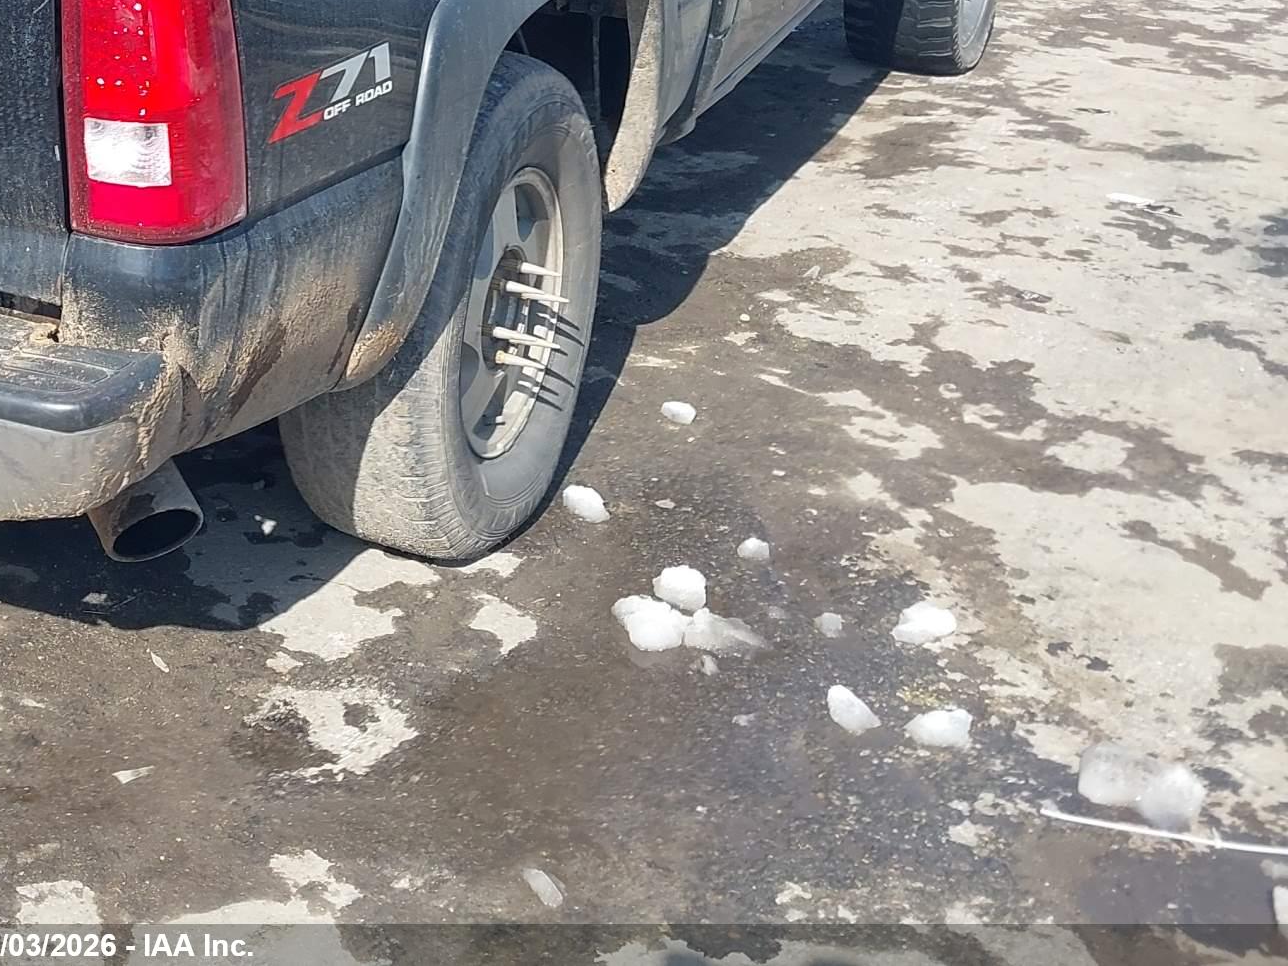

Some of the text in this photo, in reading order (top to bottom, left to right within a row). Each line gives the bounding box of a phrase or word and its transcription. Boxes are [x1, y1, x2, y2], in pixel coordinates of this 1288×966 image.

[268, 41, 392, 144] Z71
[323, 80, 393, 121] OFF ROAD
